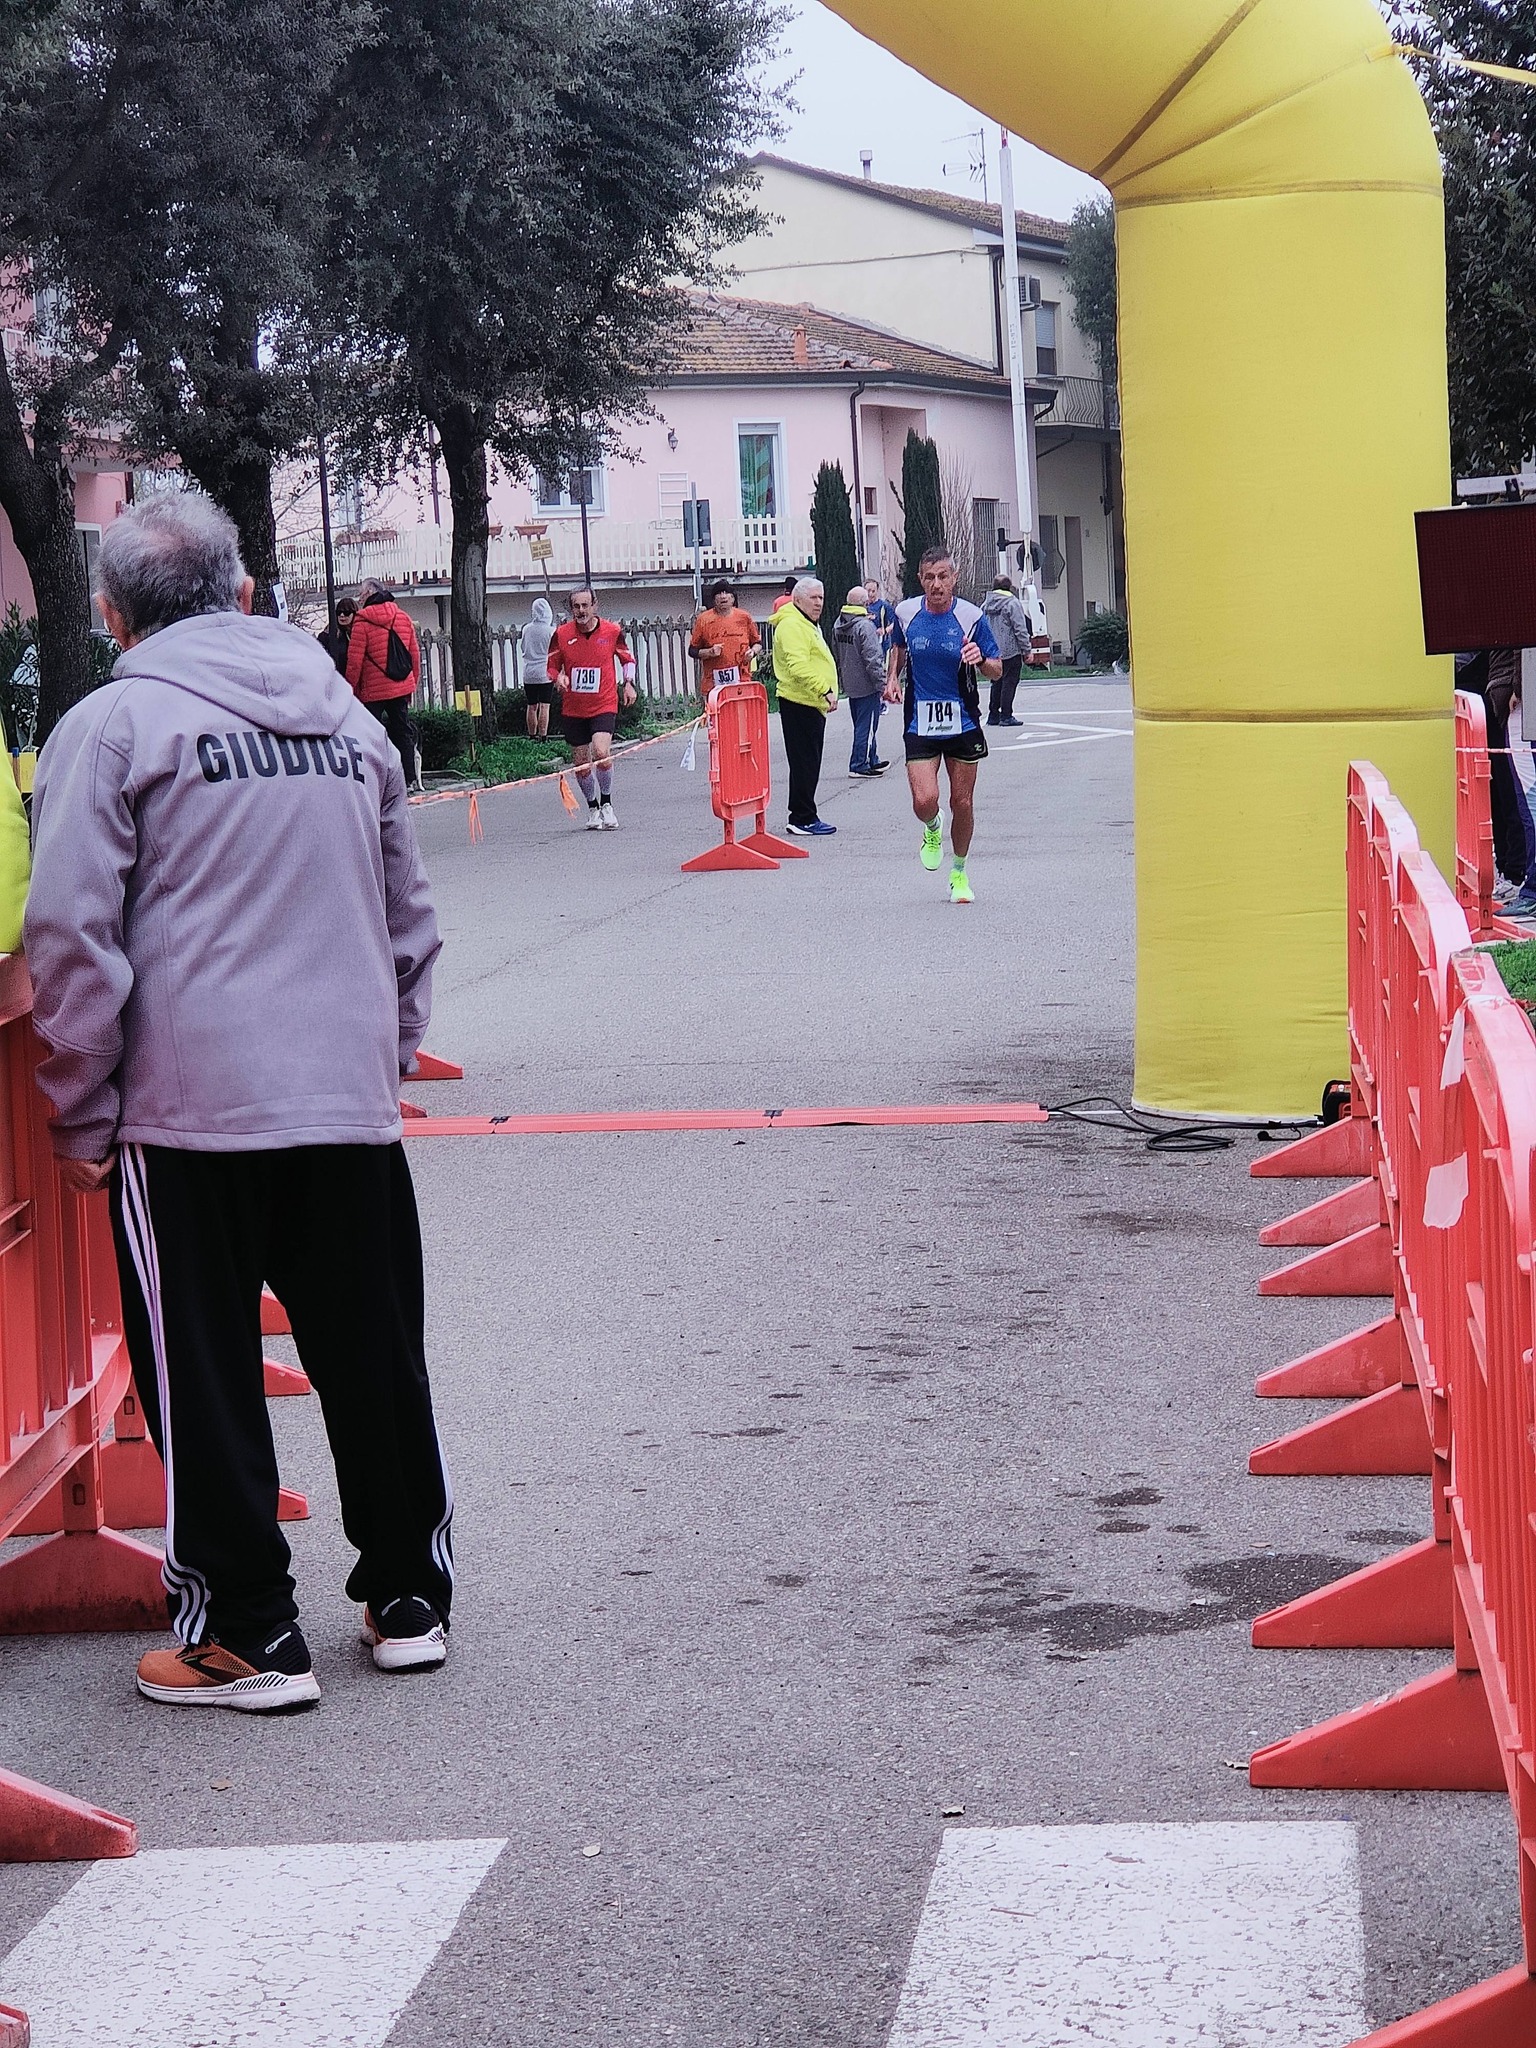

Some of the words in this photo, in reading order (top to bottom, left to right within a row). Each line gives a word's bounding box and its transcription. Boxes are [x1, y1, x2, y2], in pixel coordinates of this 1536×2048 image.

[576, 669, 595, 684] 736
[926, 701, 953, 722] 784
[197, 731, 365, 784] GIUDICE
